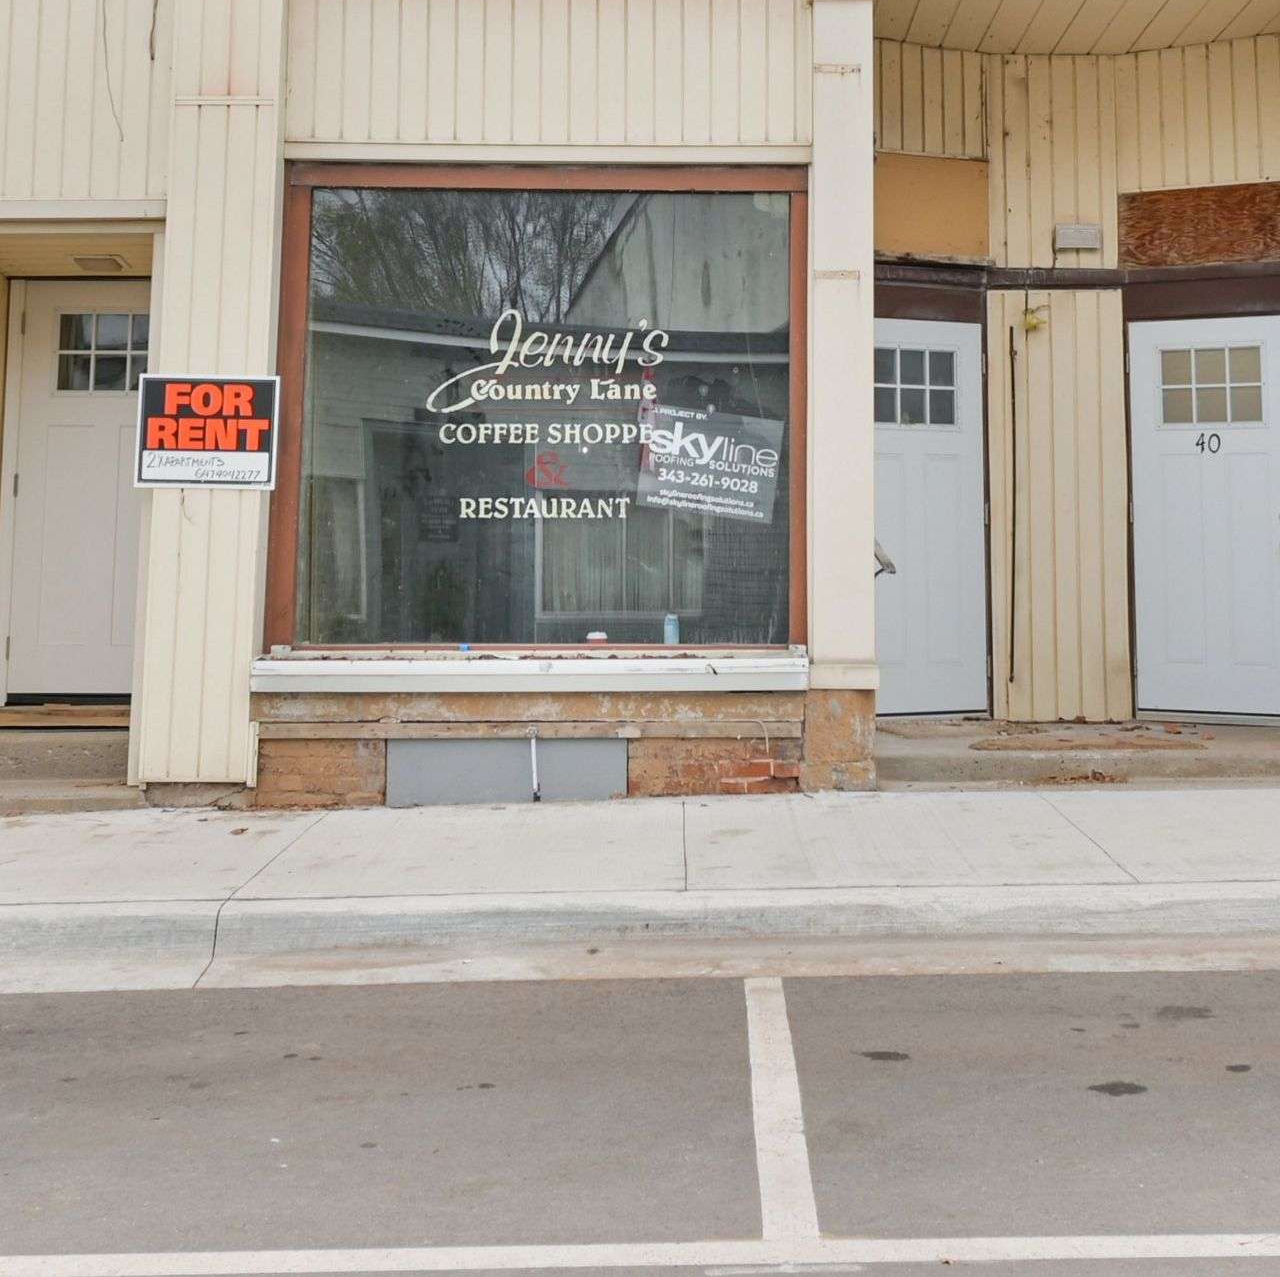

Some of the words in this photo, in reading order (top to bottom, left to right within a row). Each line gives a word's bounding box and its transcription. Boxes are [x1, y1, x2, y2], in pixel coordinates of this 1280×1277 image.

[462, 309, 669, 388] Jenny's
[164, 383, 254, 417] FOR
[471, 379, 581, 404] Country
[590, 378, 657, 401] Lane
[146, 417, 270, 451] RENT
[439, 423, 539, 444] COFFEE
[547, 423, 652, 444] SHOPPE
[649, 421, 779, 468] skyline
[1195, 432, 1221, 453] 40
[526, 451, 570, 488] &
[658, 468, 759, 494] 343-261-9028
[709, 460, 775, 478] SOLUTIONS
[459, 497, 631, 519] RESTAURANT
